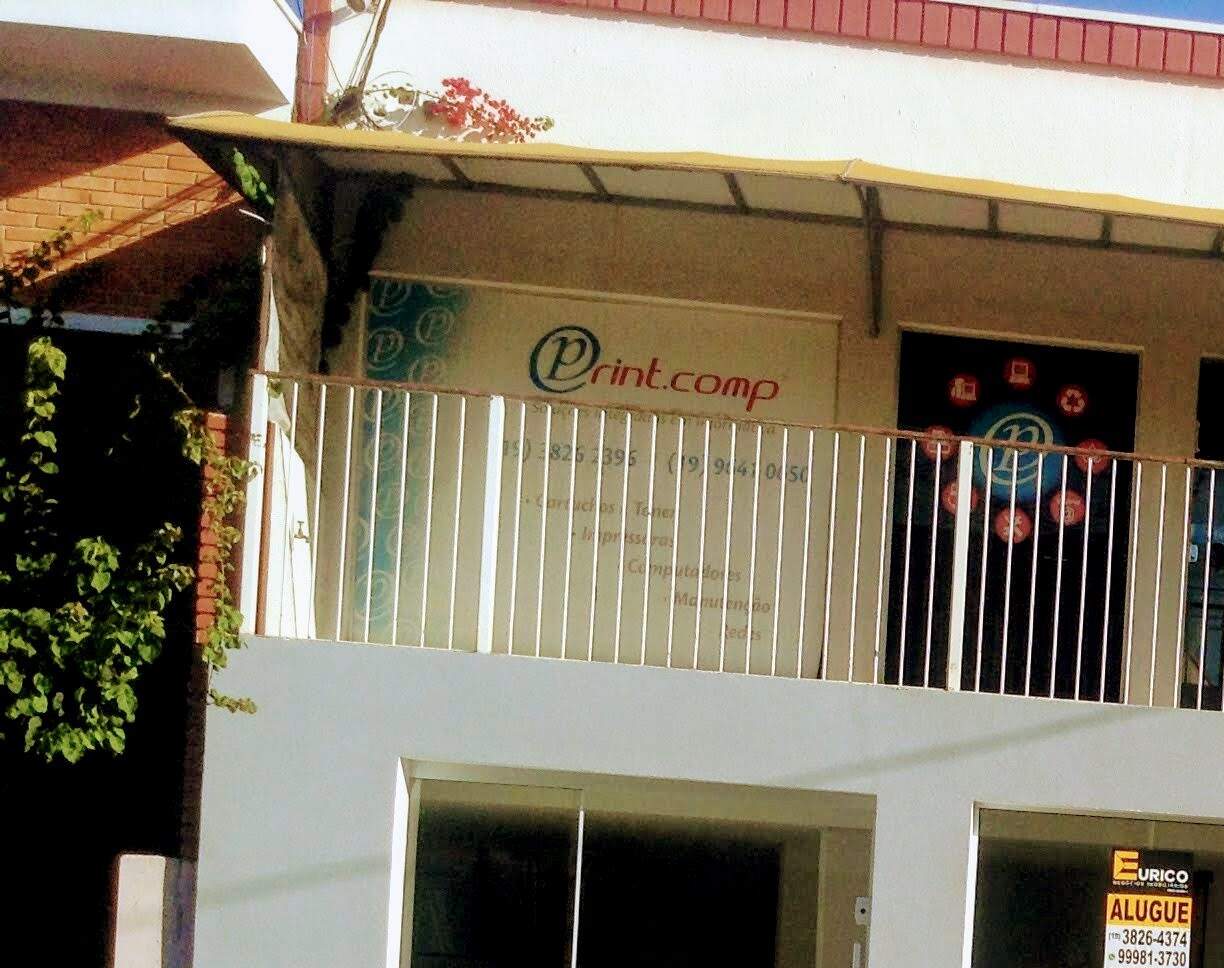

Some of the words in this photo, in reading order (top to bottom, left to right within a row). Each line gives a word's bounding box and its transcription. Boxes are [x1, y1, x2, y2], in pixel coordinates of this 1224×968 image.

[1113, 850, 1189, 884] EURICO
[1110, 898, 1190, 924] ALUGUE
[1122, 929, 1188, 947] 3826-4374
[1118, 948, 1187, 967] 99981-3730
